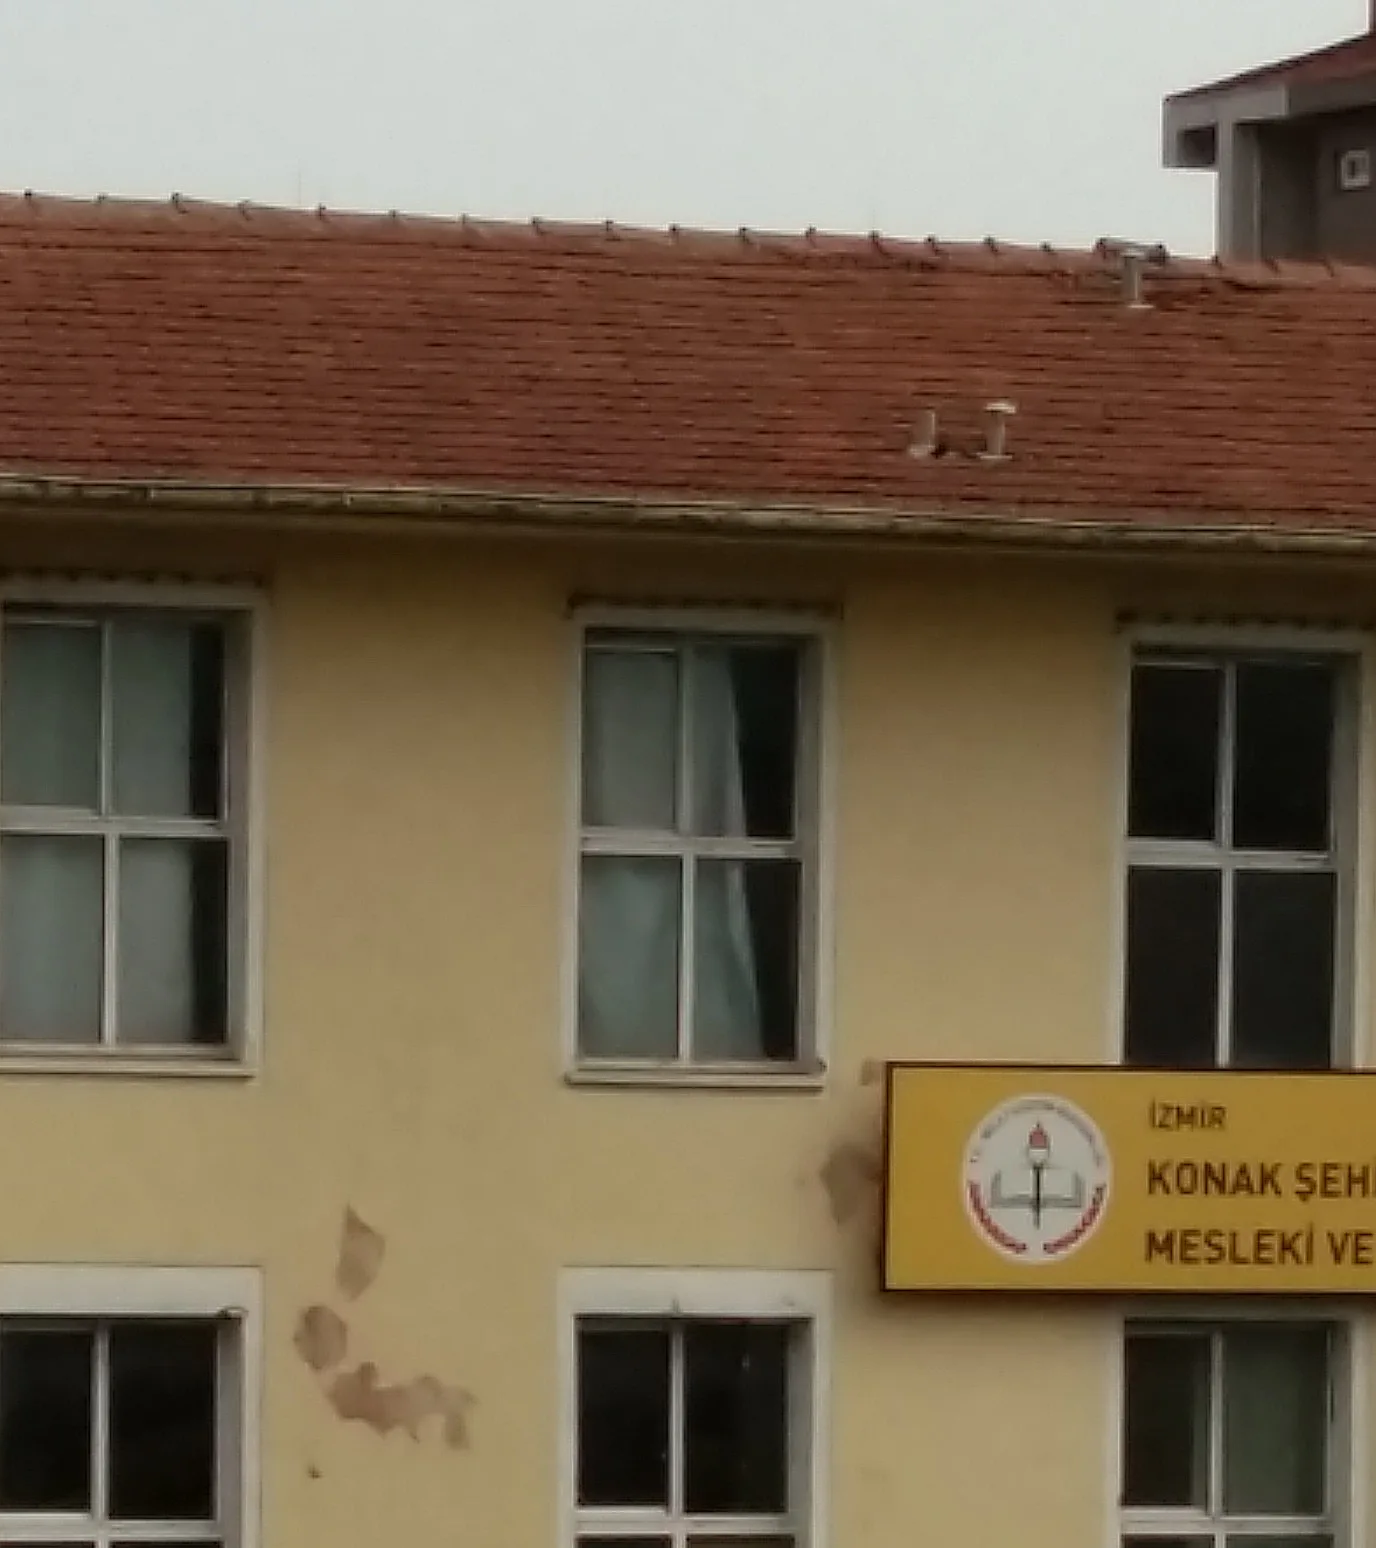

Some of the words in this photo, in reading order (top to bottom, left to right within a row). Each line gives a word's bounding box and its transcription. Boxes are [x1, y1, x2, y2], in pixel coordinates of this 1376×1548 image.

[1149, 1098, 1226, 1131] İZMİR
[1147, 1159, 1283, 1197] KONAK
[1144, 1222, 1315, 1266] MESLEKİ
[1326, 1230, 1374, 1266] VE
